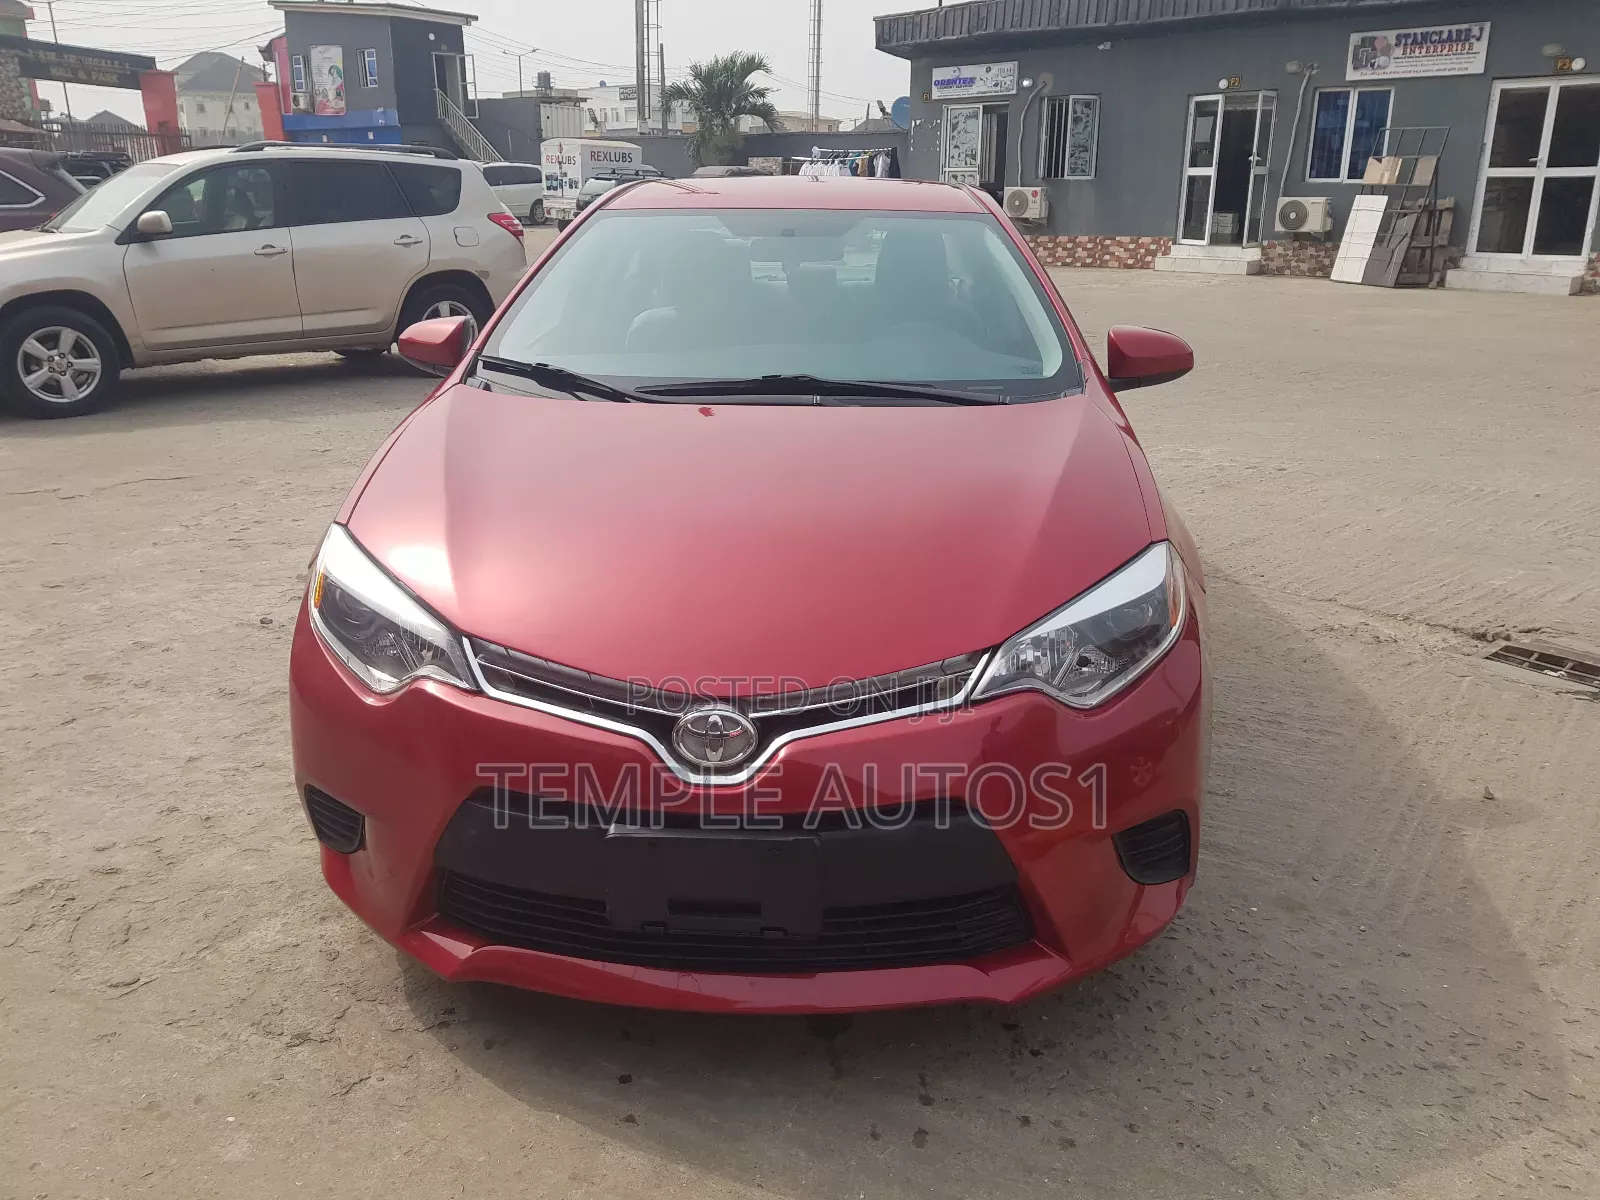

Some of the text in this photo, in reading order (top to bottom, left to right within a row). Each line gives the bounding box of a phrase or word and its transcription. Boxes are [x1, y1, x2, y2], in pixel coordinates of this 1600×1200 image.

[1401, 41, 1475, 56] ENTERPRISE
[1230, 76, 1240, 87] F2
[590, 150, 633, 164] REXLUBS
